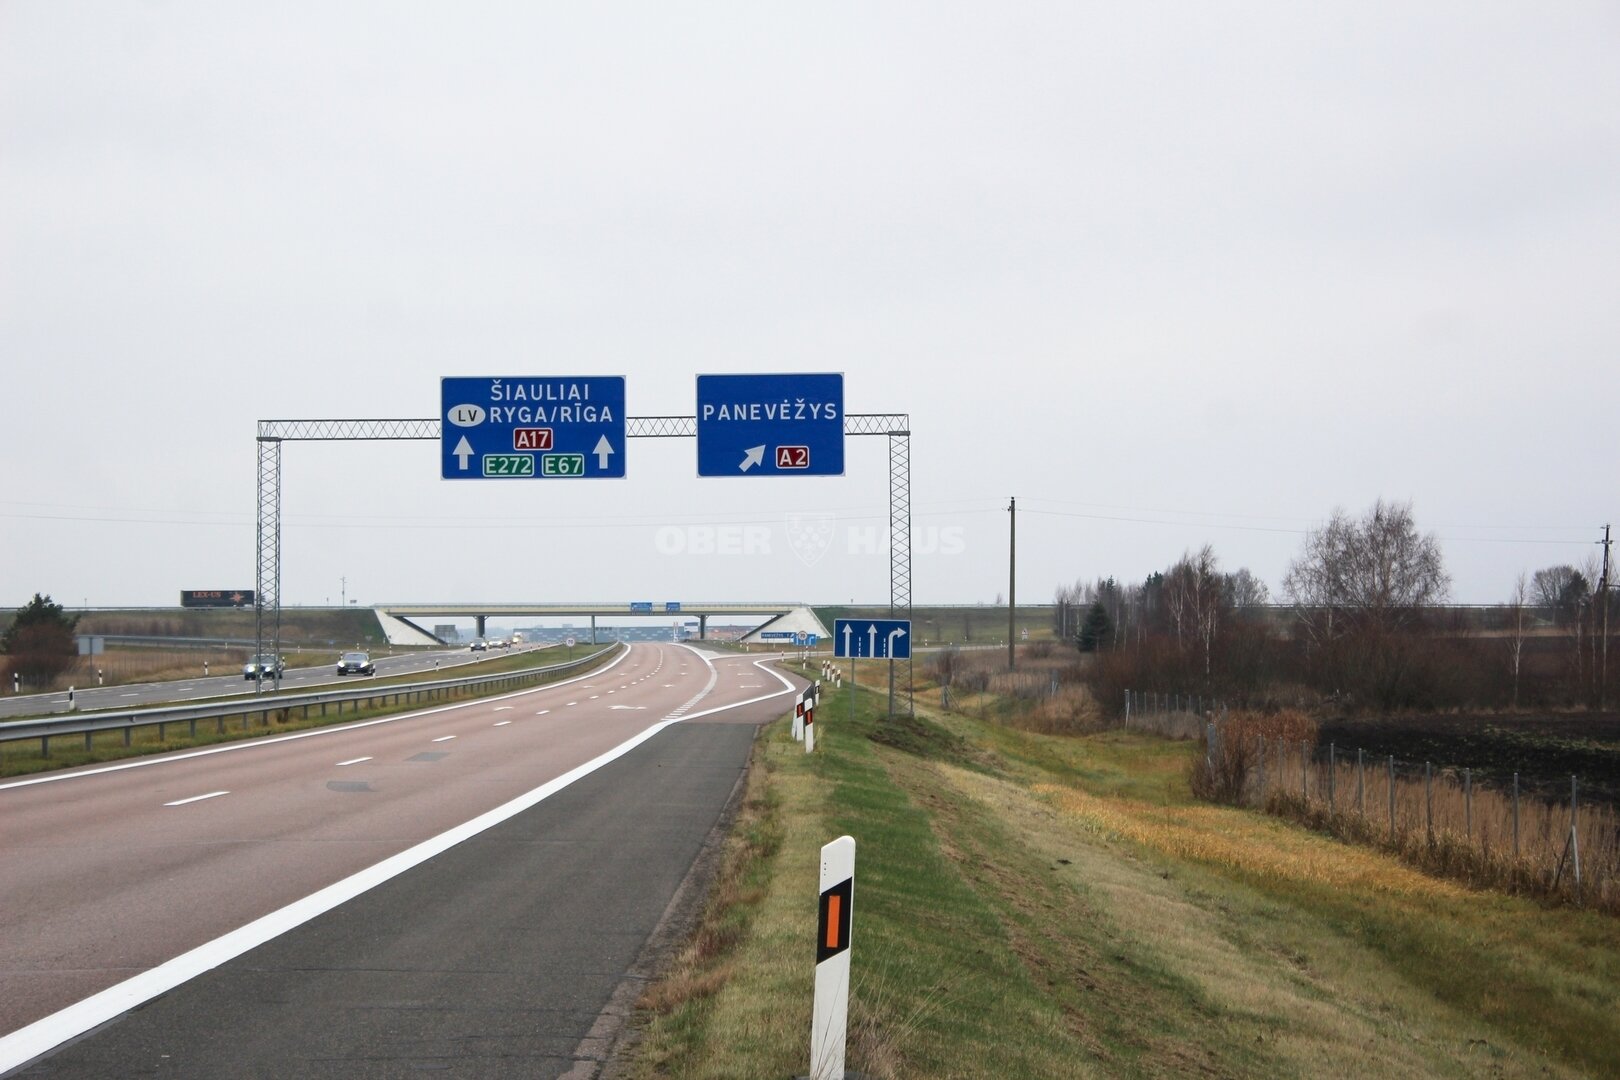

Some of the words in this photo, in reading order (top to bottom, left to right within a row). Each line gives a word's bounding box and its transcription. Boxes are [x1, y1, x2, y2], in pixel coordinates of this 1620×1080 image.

[490, 379, 589, 401] ŠIAULIAI
[458, 409, 478, 422] LV
[490, 402, 613, 423] RYGA/RĪGA
[703, 398, 837, 420] PANEVĖŽYS
[516, 431, 549, 448] A17
[485, 457, 532, 474] E272
[545, 457, 582, 474] E67
[779, 449, 806, 466] A2
